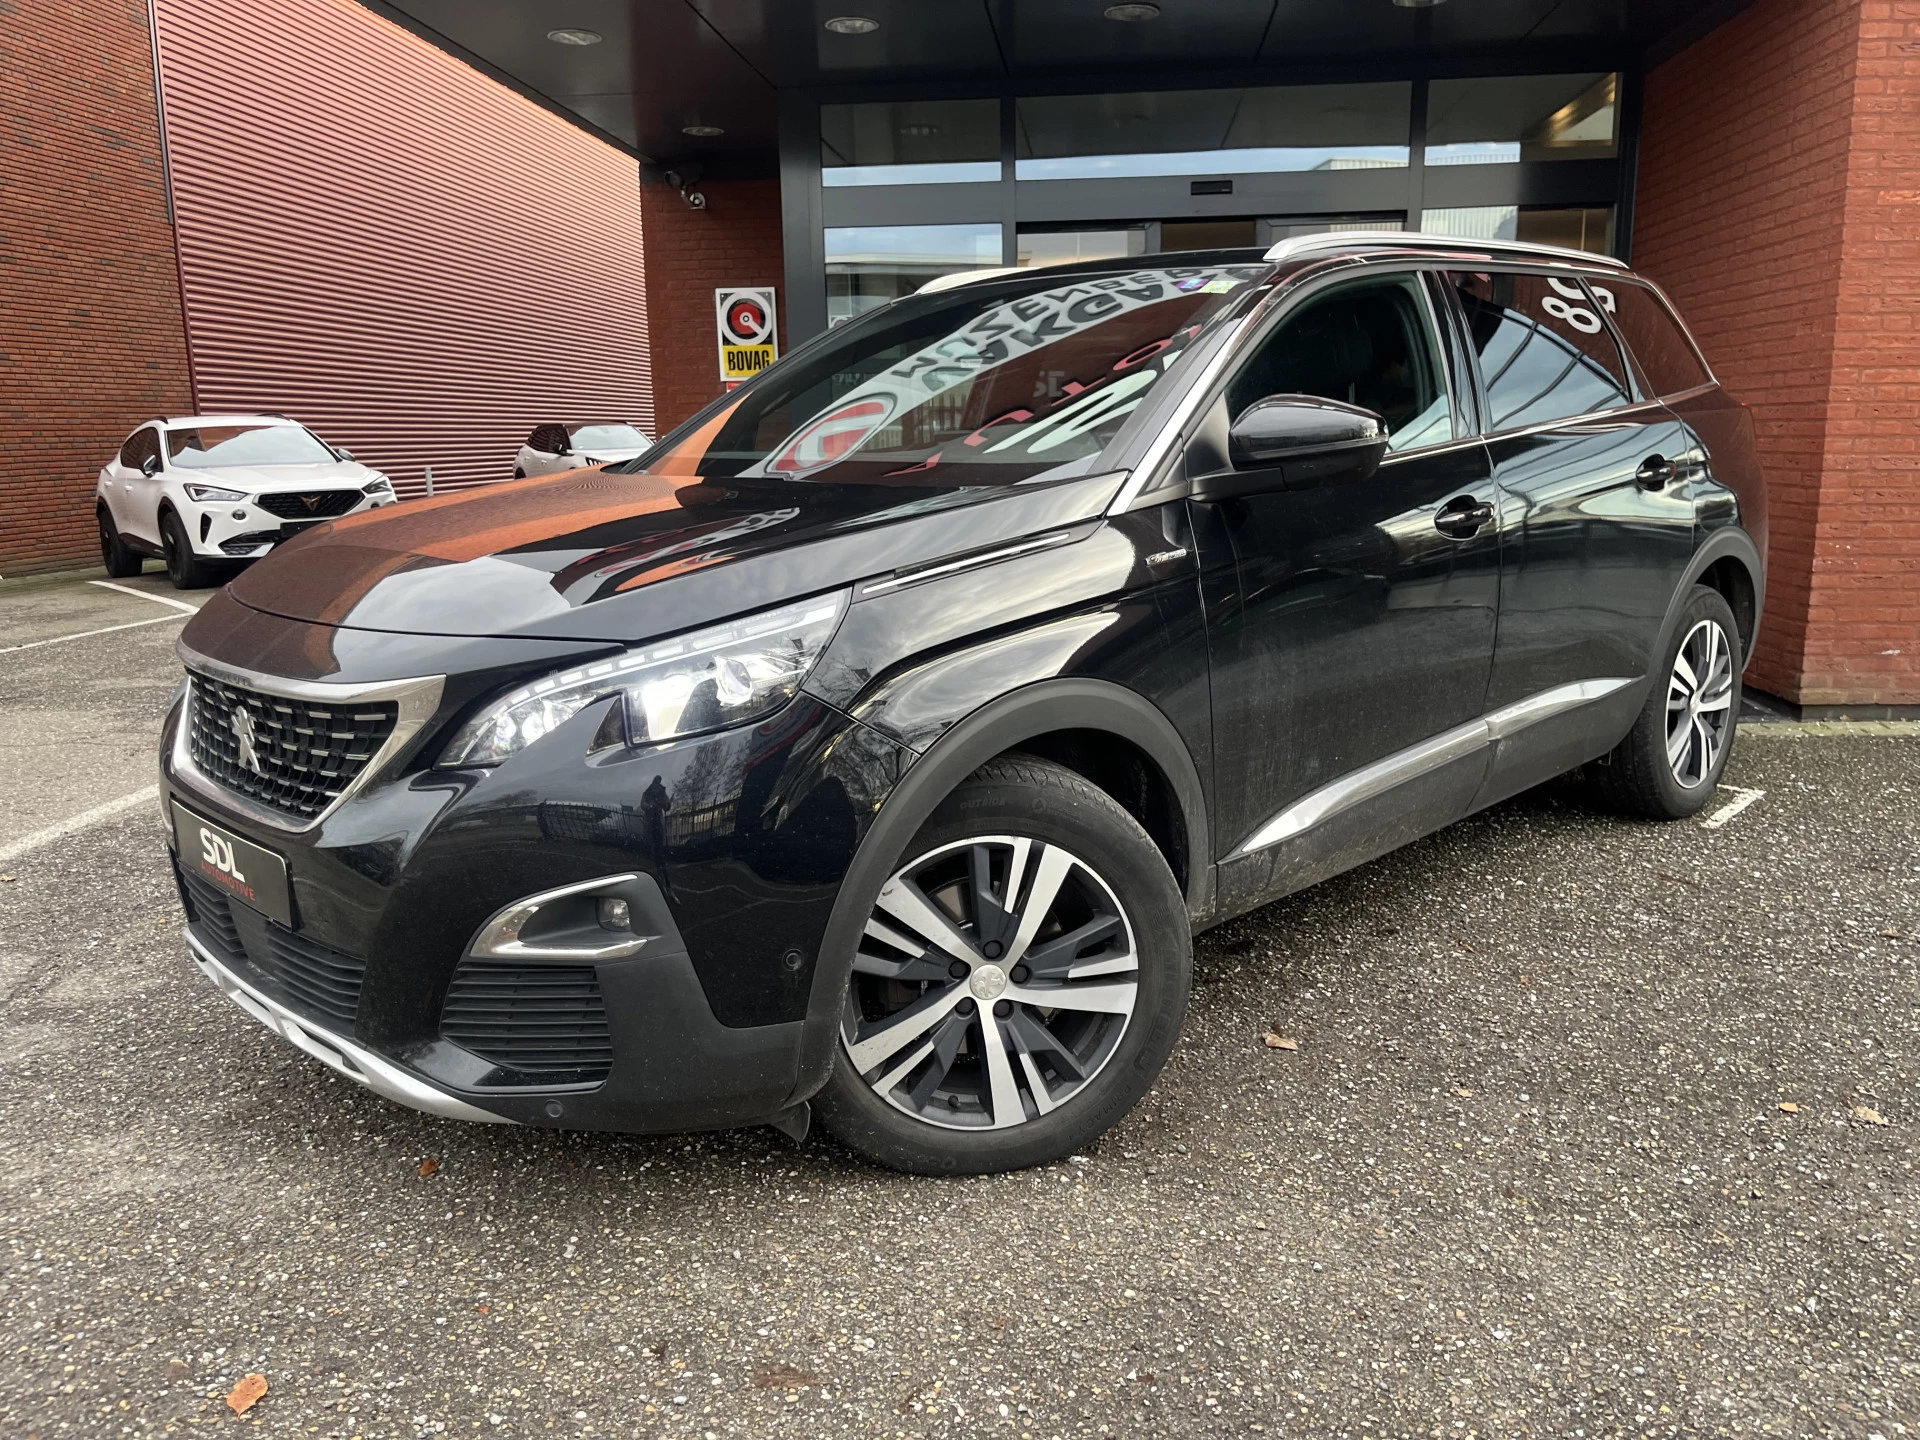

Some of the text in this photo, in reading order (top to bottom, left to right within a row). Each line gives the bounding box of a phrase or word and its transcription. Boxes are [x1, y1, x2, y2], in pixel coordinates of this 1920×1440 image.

[727, 350, 770, 371] BOVAG
[199, 827, 246, 883] SDL
[200, 860, 256, 902] AUTOMOTIVE
[1080, 1083, 1132, 1134] PRIMACY
